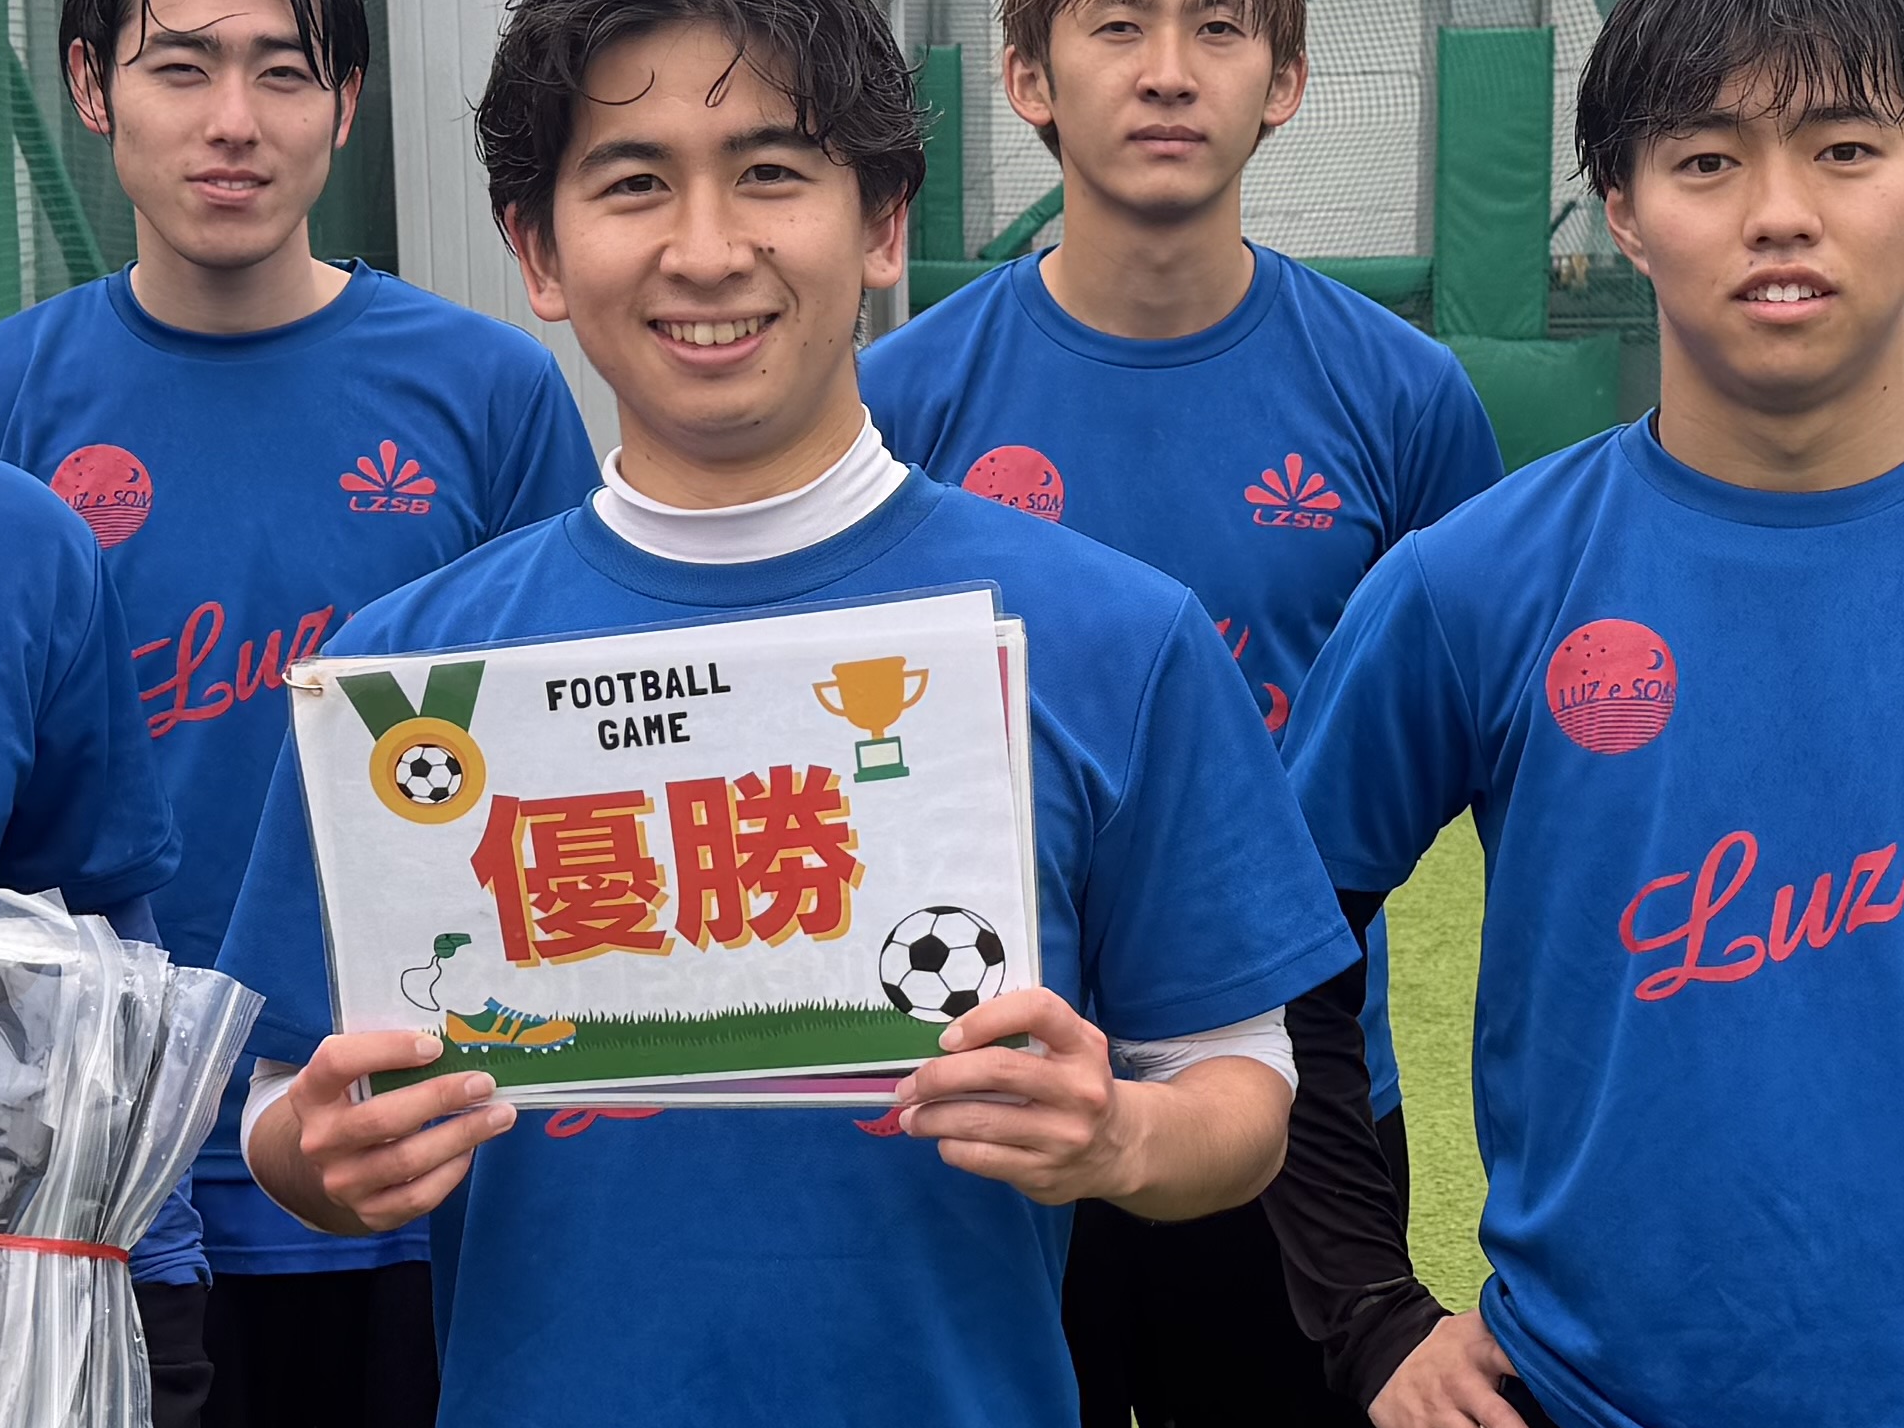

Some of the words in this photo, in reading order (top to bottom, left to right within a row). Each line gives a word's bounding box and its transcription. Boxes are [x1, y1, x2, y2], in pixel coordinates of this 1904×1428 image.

[349, 495, 432, 516] LZSB
[1253, 507, 1336, 531] LZSB
[545, 662, 732, 712] FOOTBALL
[1559, 680, 1601, 710] LUZ
[1608, 683, 1622, 700] e
[598, 711, 691, 751] GAME
[469, 764, 867, 968] 優勝
